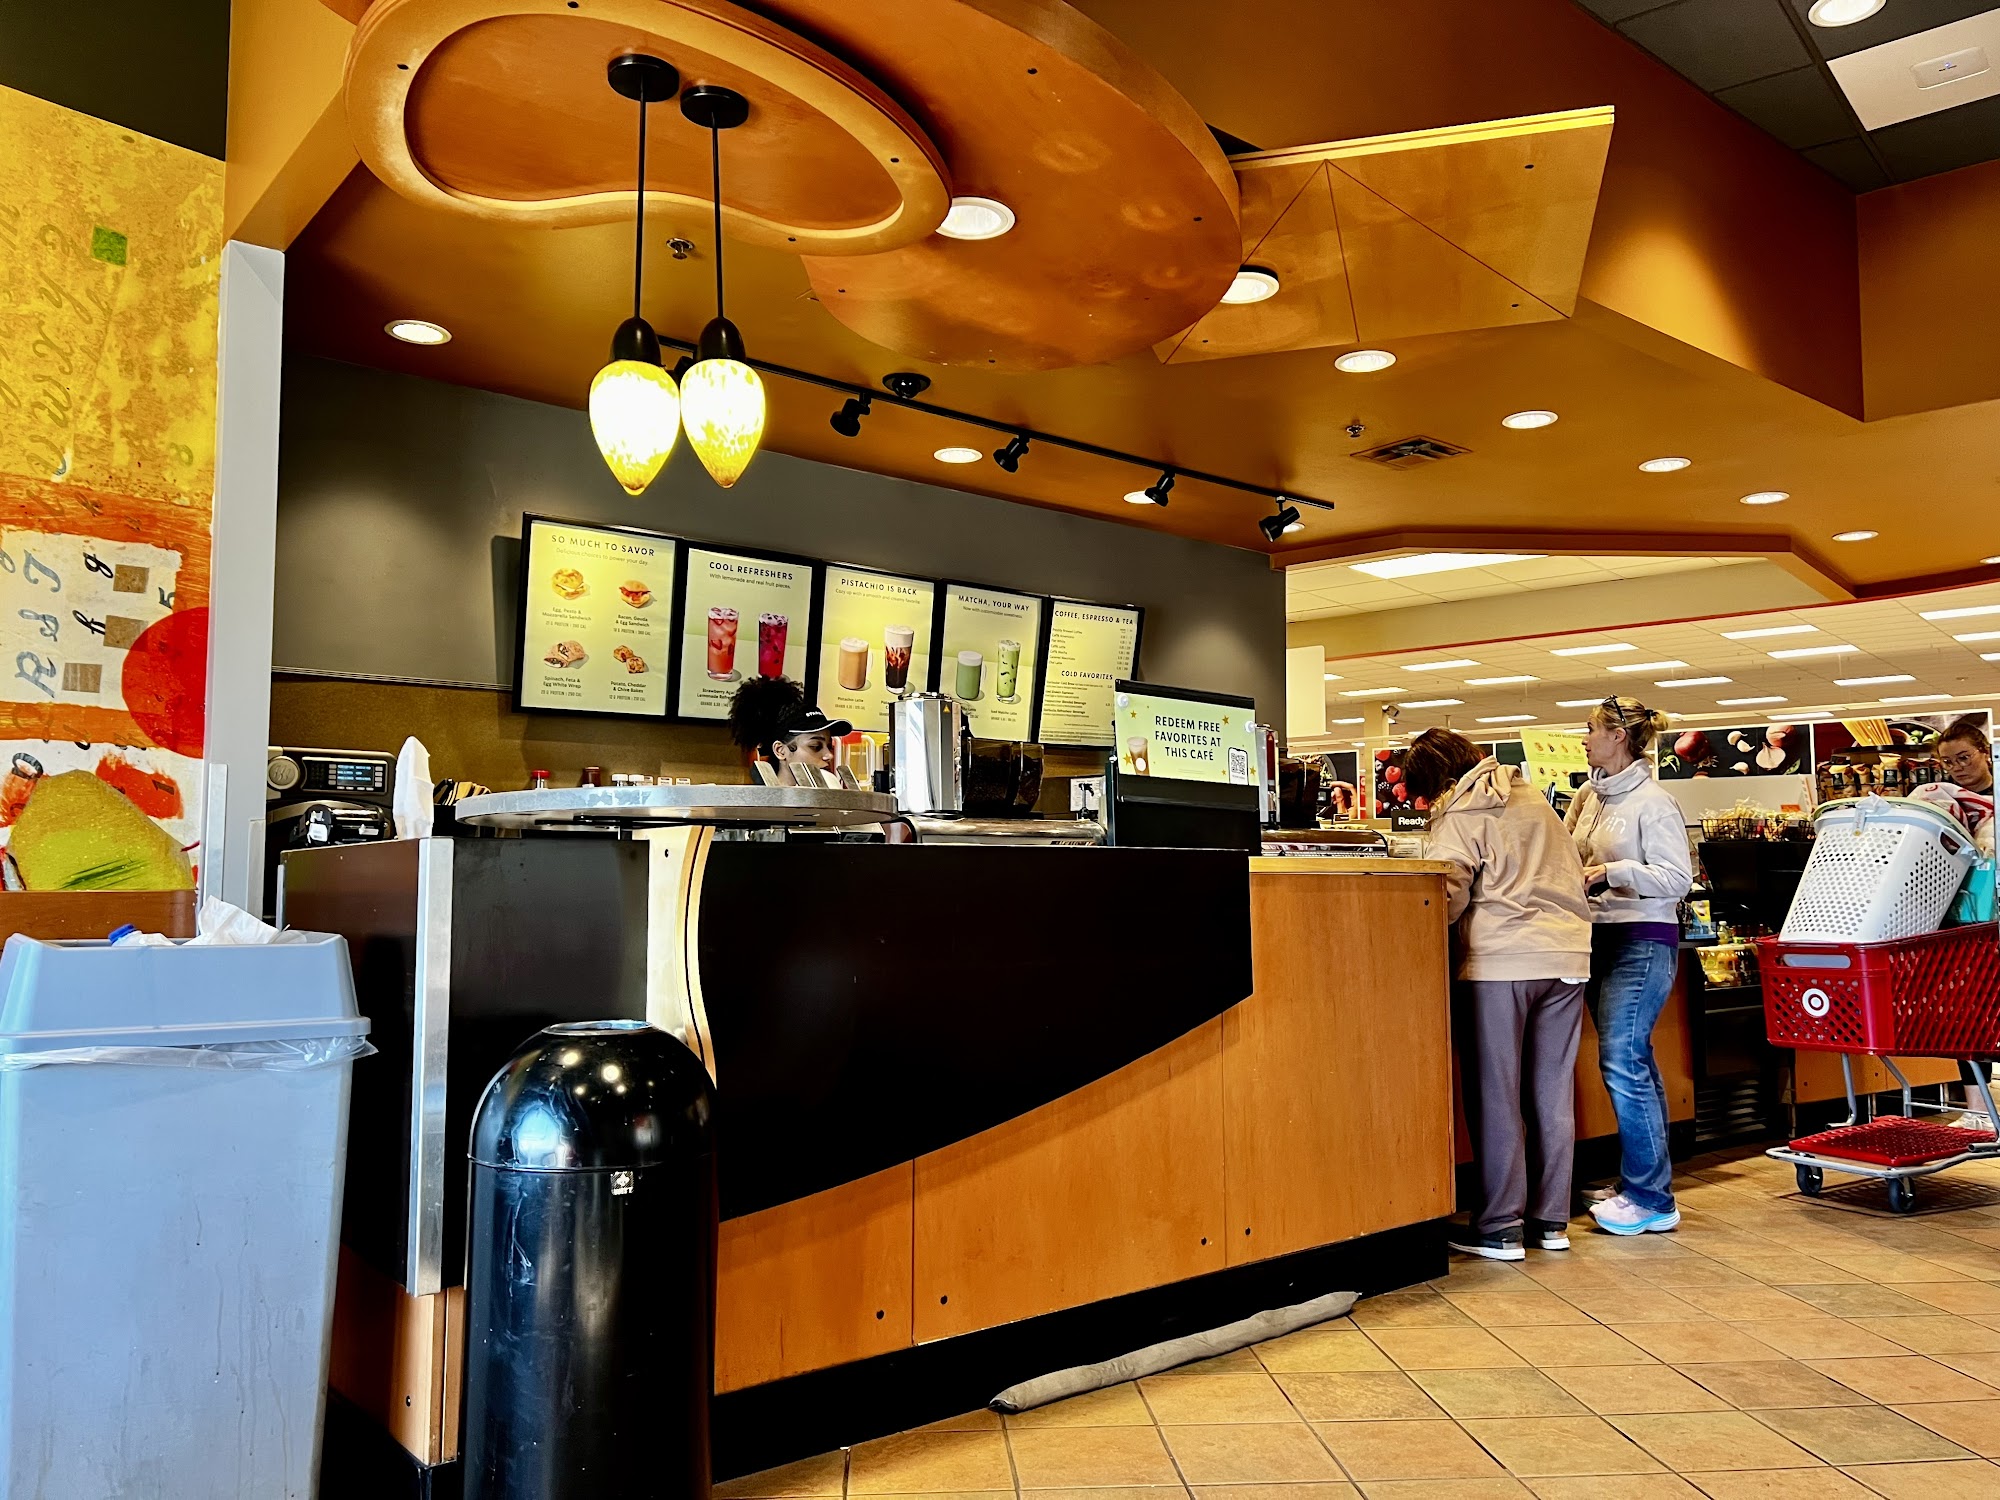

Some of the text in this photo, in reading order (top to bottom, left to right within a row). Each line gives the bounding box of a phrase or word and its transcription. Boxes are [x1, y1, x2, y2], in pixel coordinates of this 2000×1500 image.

[552, 535, 655, 556] SO MUCH TO SAVOR
[709, 561, 793, 580] COOL REFRESHERS
[722, 575, 745, 583] lemonade
[841, 578, 884, 590] PISTACHIO
[897, 587, 917, 596] BACK
[958, 595, 990, 606] MATCHA,
[992, 600, 1012, 609] YOUR
[1055, 610, 1080, 619] COFFEE,
[1082, 614, 1113, 623] ESPRESSO
[1079, 672, 1113, 680] FAVORITES
[1155, 715, 1220, 733] REDEEM FREE
[1155, 731, 1221, 747] FAVORITES AT
[1165, 746, 1214, 761] THIS CAFÉ
[1398, 817, 1426, 827] Ready
